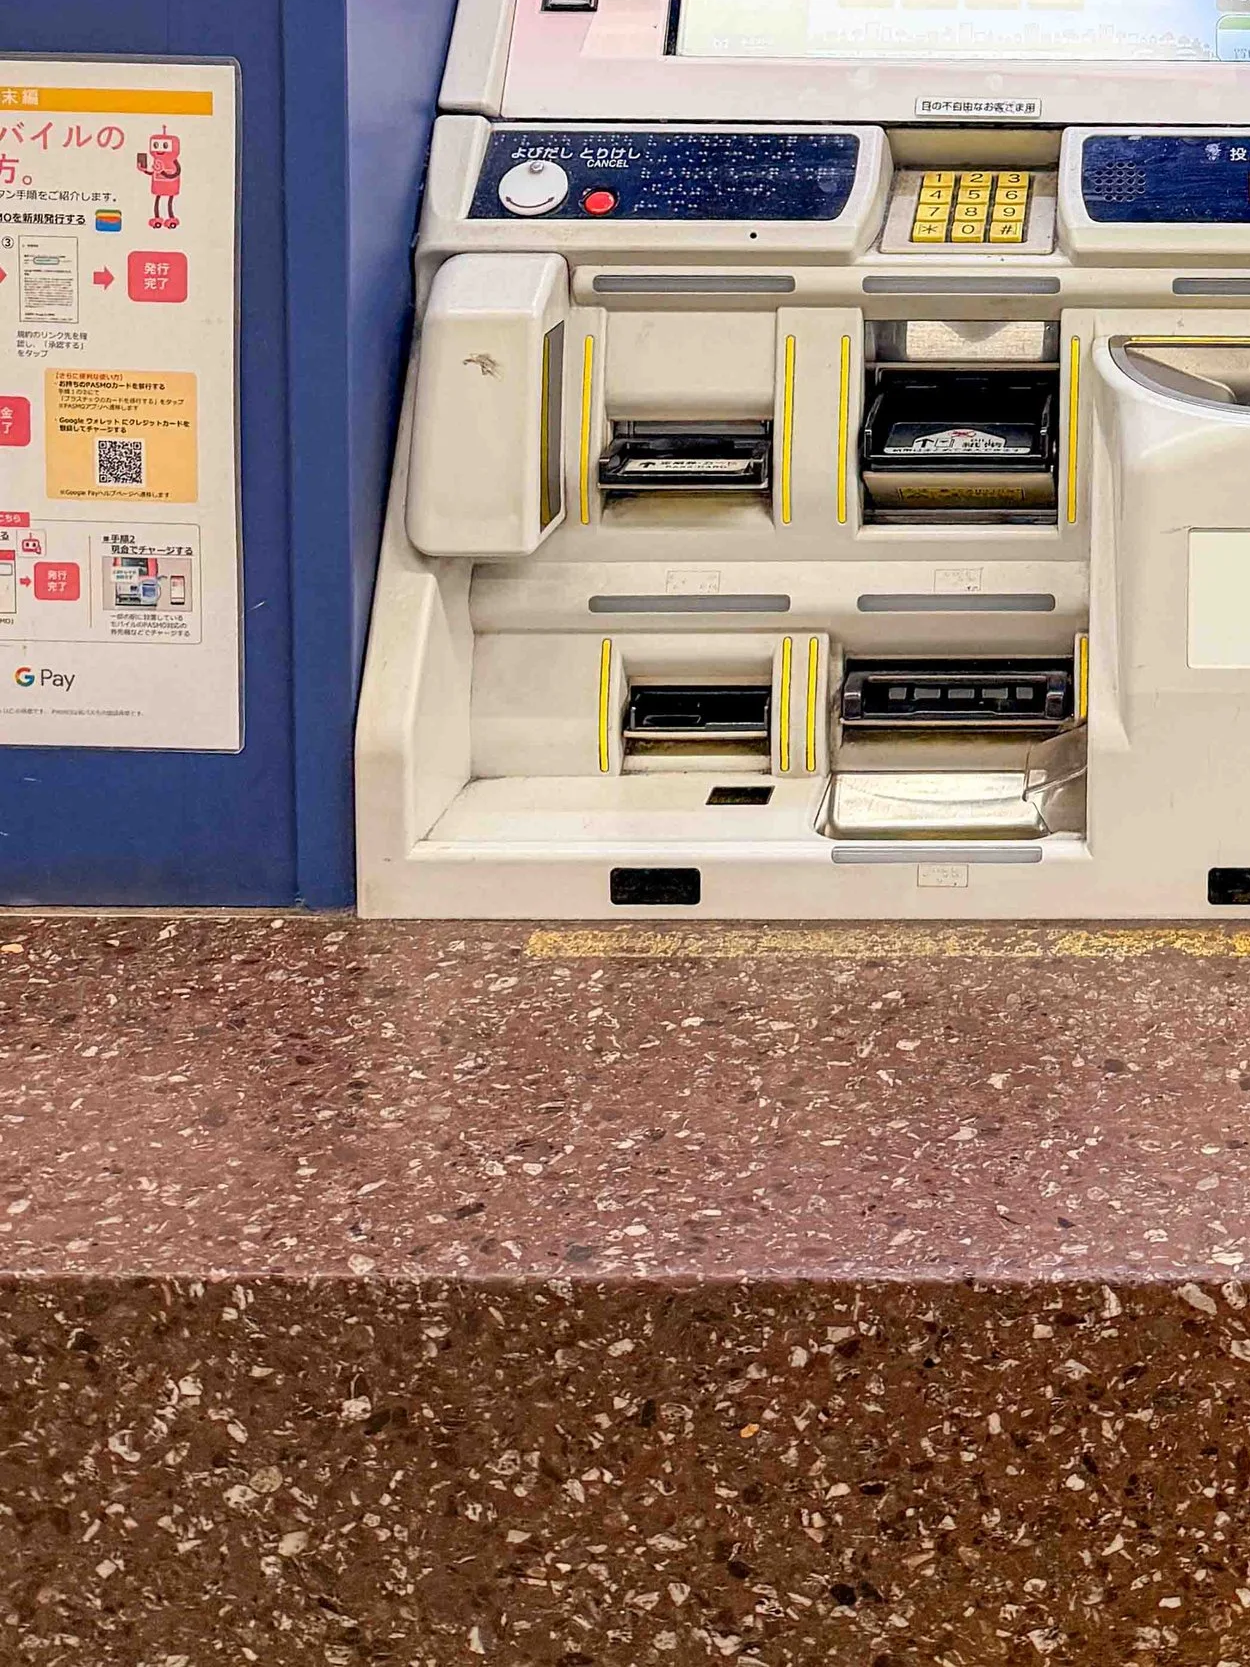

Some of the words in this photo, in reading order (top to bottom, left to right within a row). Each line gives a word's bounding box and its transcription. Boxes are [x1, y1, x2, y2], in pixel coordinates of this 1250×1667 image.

[510, 145, 573, 160] よびだし
[579, 147, 641, 161] とりけし
[586, 159, 629, 168] CANCEL
[936, 173, 942, 182] 1
[969, 173, 983, 183] 2
[1007, 174, 1020, 183] 3
[929, 190, 941, 200] 4
[968, 190, 980, 200] 5
[1005, 190, 1018, 200] 6
[928, 207, 940, 217] 7
[964, 207, 977, 217] 8
[1003, 207, 1016, 217] 9
[961, 224, 975, 234] 0
[144, 263, 170, 276] 発行
[144, 277, 169, 291] 完了
[40, 669, 75, 691] Pay
